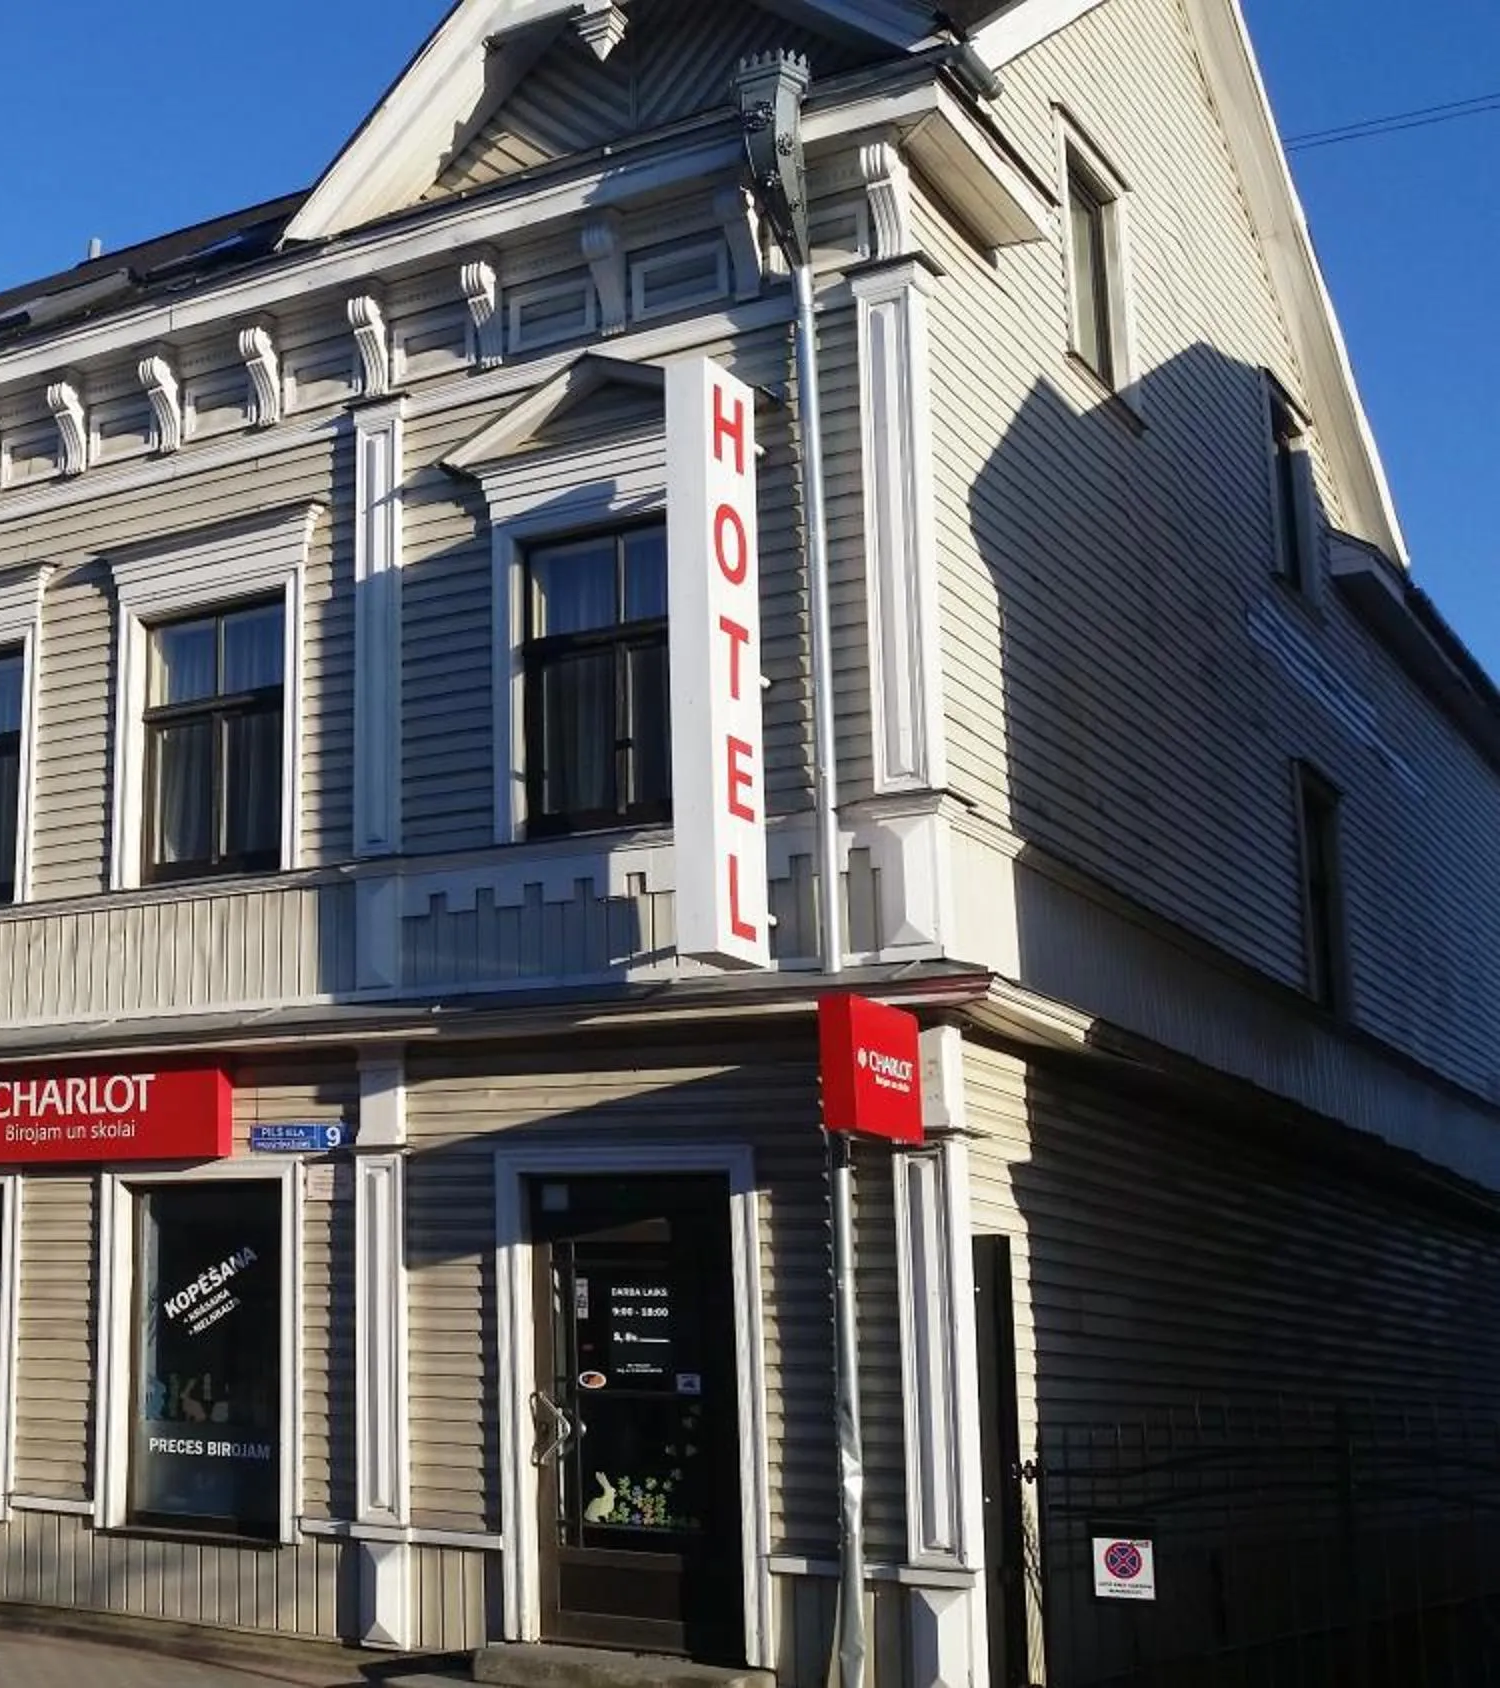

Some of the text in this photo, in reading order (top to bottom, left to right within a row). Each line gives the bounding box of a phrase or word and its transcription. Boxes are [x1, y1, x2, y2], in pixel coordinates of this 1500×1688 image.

[712, 384, 758, 943] HOTEL
[5, 1119, 136, 1145] Birojam un skolai
[326, 1126, 341, 1147] 9
[163, 1246, 259, 1319] KOPĒŠANA
[149, 1437, 271, 1460] PRECES BIROJAM
